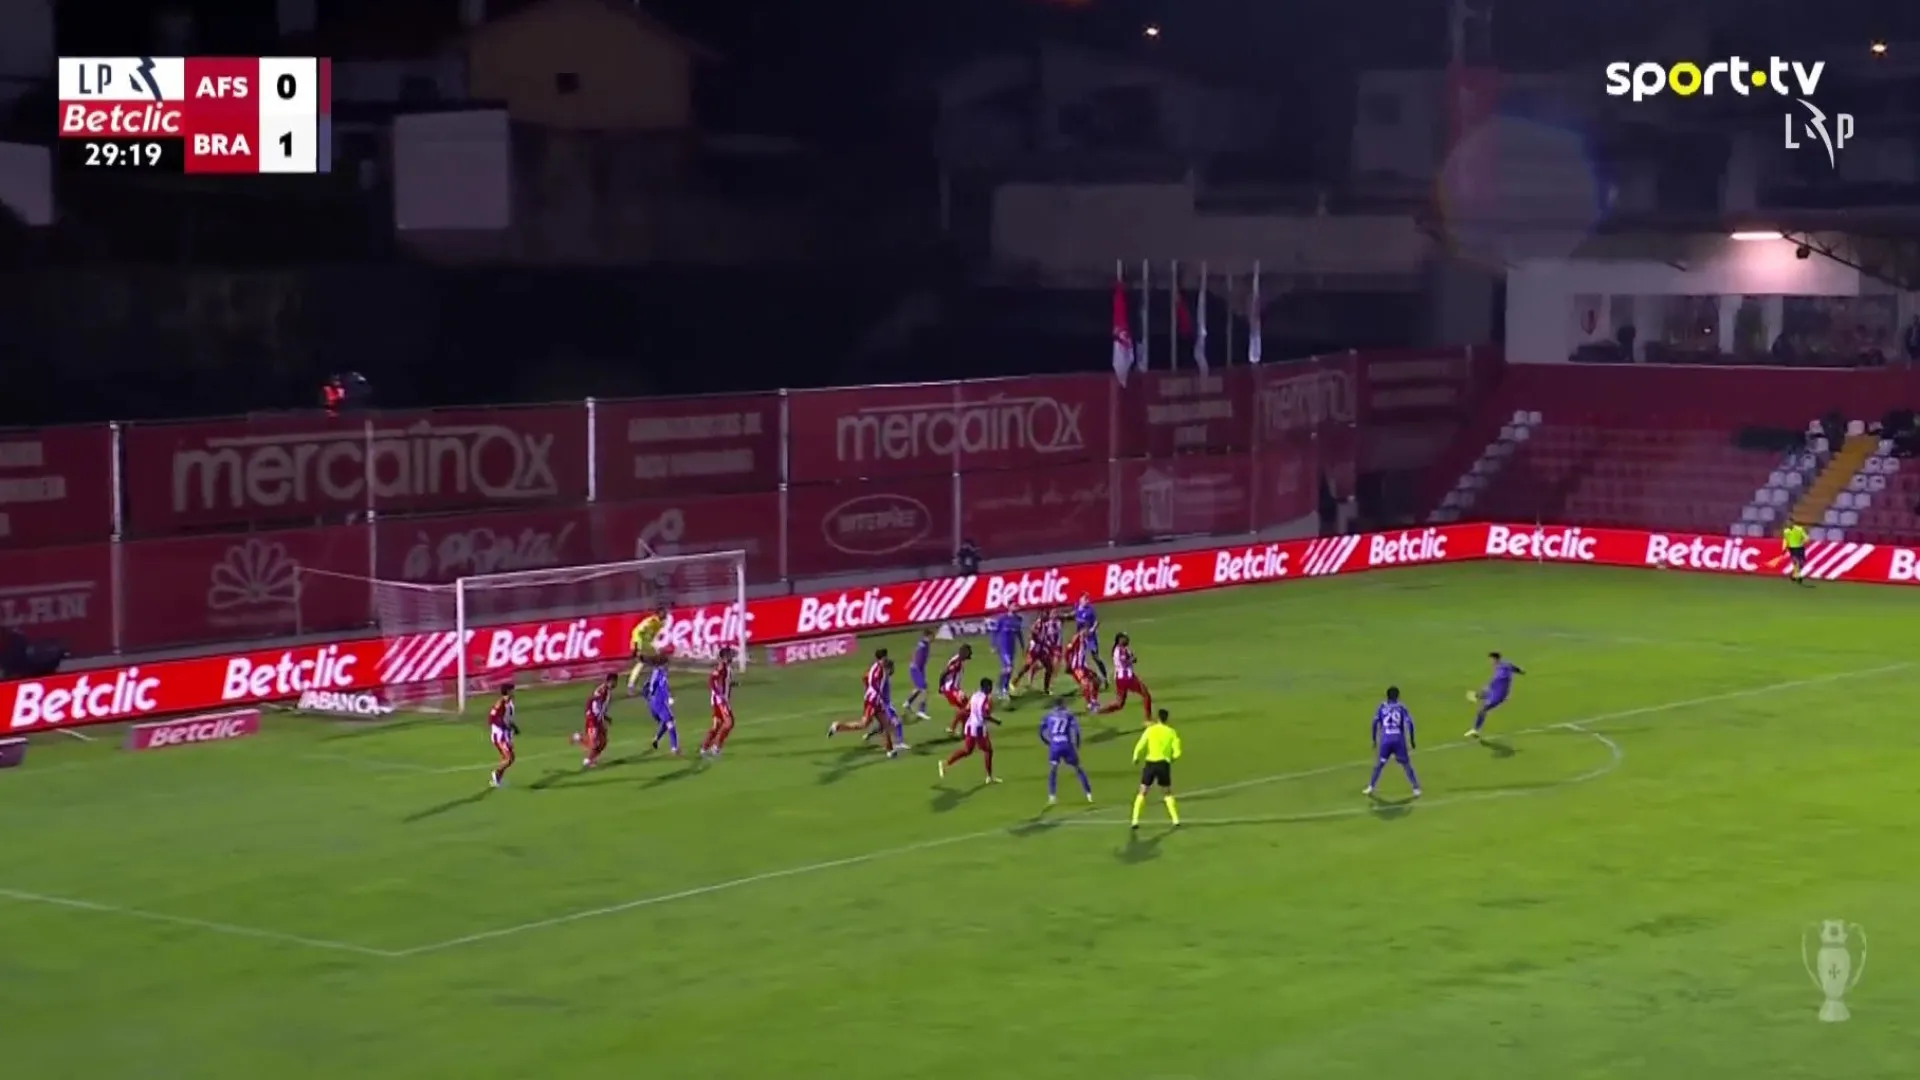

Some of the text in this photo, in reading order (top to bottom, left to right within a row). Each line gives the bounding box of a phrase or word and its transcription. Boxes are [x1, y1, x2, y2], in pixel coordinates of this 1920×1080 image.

[1368, 528, 1448, 565] Betclic
[1487, 526, 1596, 560] Betclic
[1646, 534, 1760, 571] Betclic
[1103, 558, 1183, 597] Betclic
[1215, 547, 1288, 585] Betclic
[984, 569, 1069, 608] Betclic
[797, 588, 893, 633] Betclic
[486, 617, 604, 668] Betclic
[785, 641, 848, 662] Betclic
[221, 644, 357, 700] Betclic
[10, 667, 160, 728] Betclic
[149, 717, 247, 748] Betclic
[1381, 709, 1401, 727] 29
